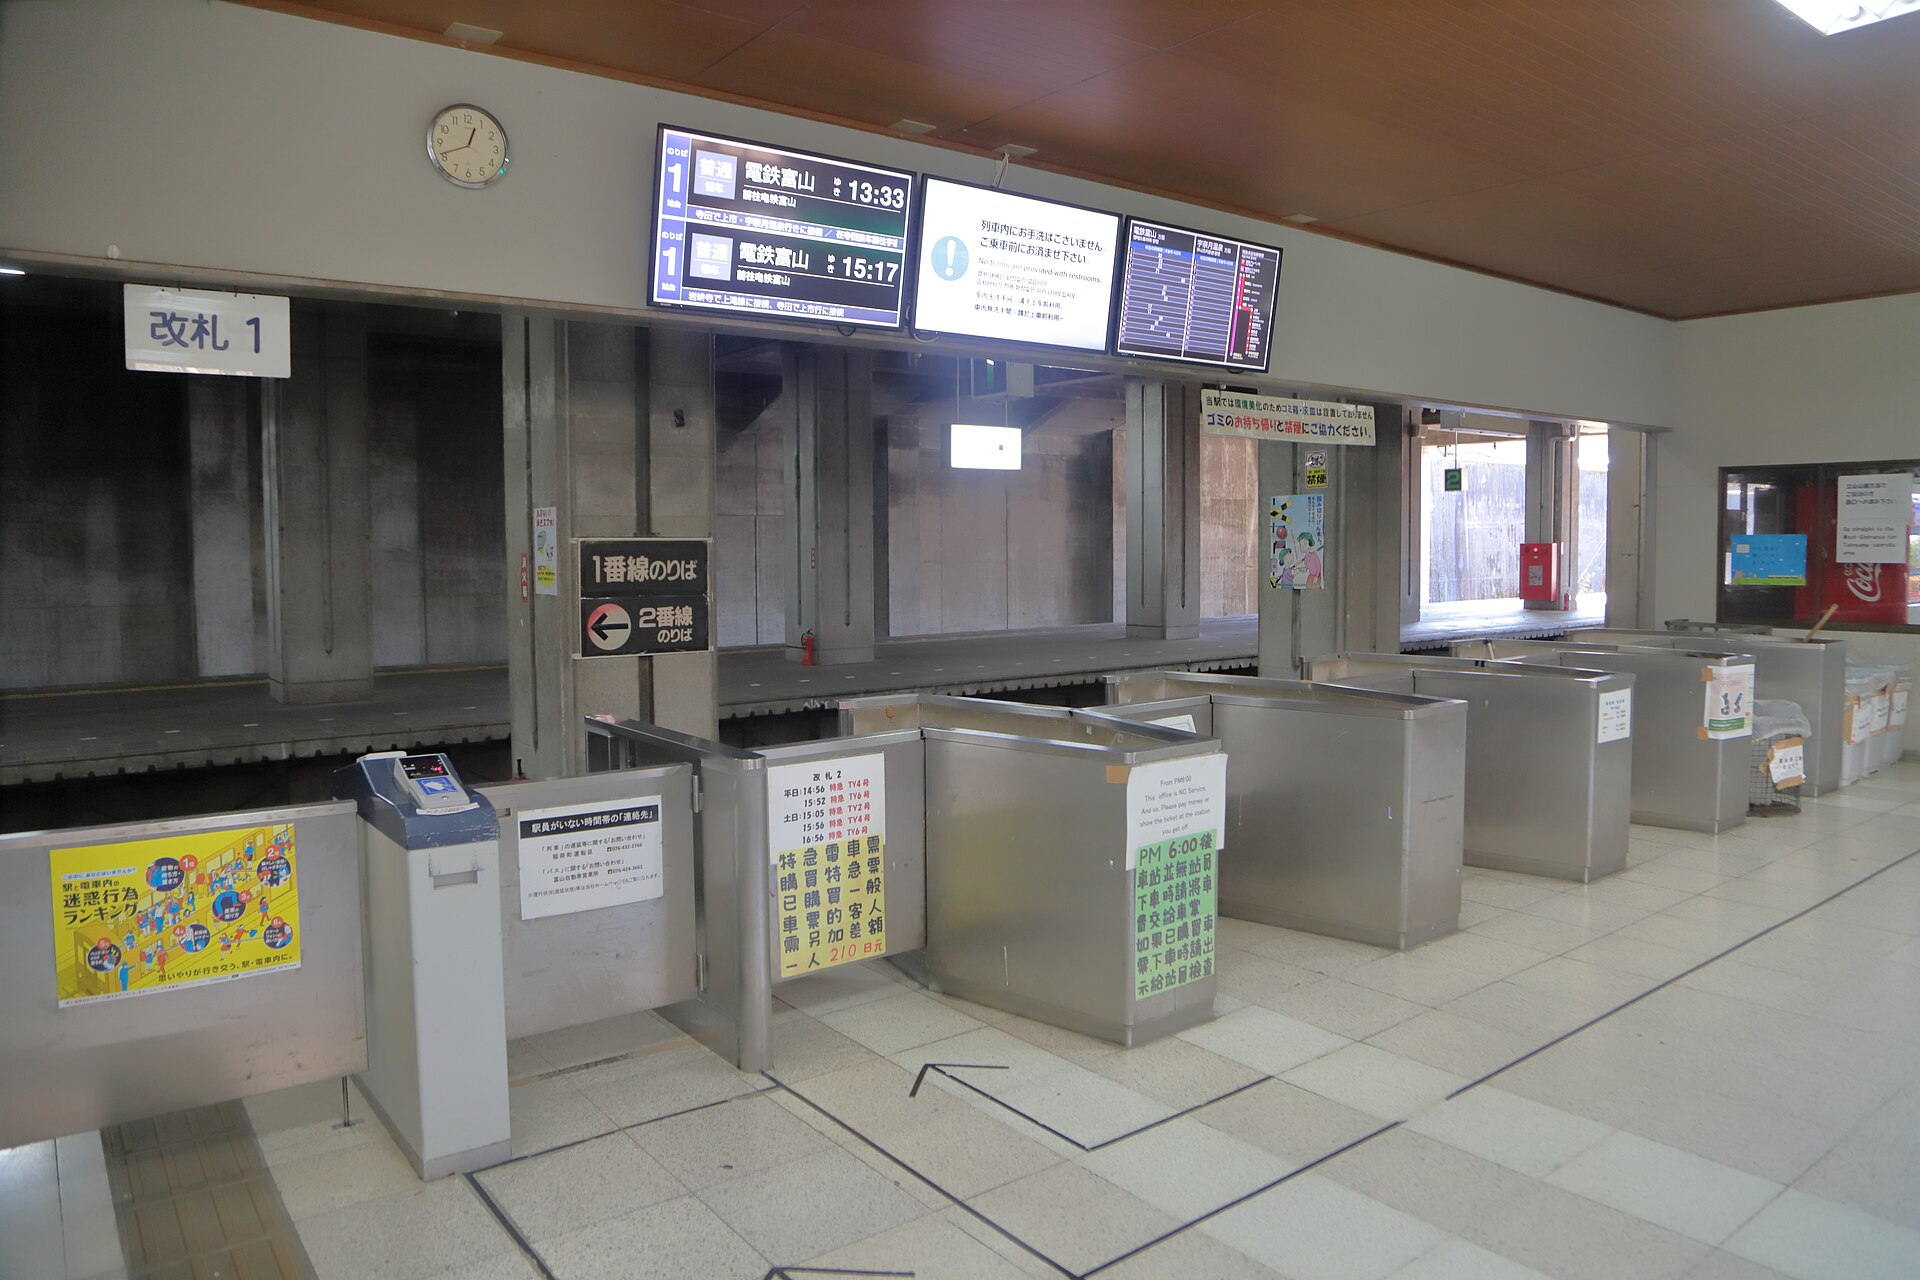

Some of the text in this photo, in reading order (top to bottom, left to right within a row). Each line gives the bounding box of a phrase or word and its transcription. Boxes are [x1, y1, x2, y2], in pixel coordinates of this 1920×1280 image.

[452, 116, 458, 126] 11
[464, 114, 472, 124] 12
[440, 125, 449, 134] 10
[488, 131, 494, 140] 2
[437, 138, 443, 147] 9
[493, 146, 499, 154] 3
[441, 153, 448, 162] 8
[667, 147, 688, 158] のりば
[453, 164, 458, 173] 7
[480, 167, 485, 176] 5
[488, 159, 494, 167] 4
[466, 169, 471, 178] 6
[668, 162, 682, 193] 1
[745, 161, 815, 192] 電鉄富山
[849, 180, 904, 209] 13:33
[662, 232, 683, 241] のりば
[663, 246, 677, 276] 1
[740, 242, 809, 270] 電鉄富山
[842, 256, 899, 283] 15:17
[1024, 265, 1053, 276] provided
[1054, 270, 1068, 278] with
[1068, 273, 1102, 284] restrooms.
[150, 312, 260, 353] 改札 1
[1207, 414, 1372, 438] ゴミのお持ち帰りと禁煙にご協力ください。
[1307, 474, 1327, 485] 禁煙
[1447, 472, 1460, 490] 2
[592, 555, 697, 583] 1番線のりば
[639, 606, 693, 628] 2番線
[658, 628, 693, 643] のりば
[813, 770, 842, 782] 改札 2
[829, 782, 844, 792] 特急
[1158, 792, 1172, 800] office
[1179, 788, 1187, 796] NO
[804, 797, 826, 808] 15:52
[830, 795, 844, 804] 特急
[1161, 802, 1177, 811] Please
[1178, 801, 1187, 809] pay
[1188, 798, 1203, 806] money
[829, 807, 843, 816] 特急
[1140, 820, 1153, 828] show
[1154, 817, 1162, 825] the
[1164, 814, 1178, 823] ticket
[1185, 811, 1193, 819] the
[1194, 808, 1210, 817] station
[532, 810, 652, 833] 駅員がいない時間帯の「連絡先」
[803, 822, 825, 832] 15:56
[829, 819, 843, 828] 特急
[802, 834, 824, 844] 16:56
[828, 831, 842, 840] 特急
[1162, 828, 1172, 836] you
[1173, 827, 1181, 835] get
[779, 835, 880, 870] 特急電車需
[1140, 846, 1161, 866] PM
[780, 857, 880, 892] 購買特急票
[1137, 853, 1212, 890] 車站並無站員
[63, 880, 119, 892] 駅と電車内の
[784, 878, 881, 911] 已購買一般
[1138, 875, 1212, 912] 下車時請將車
[64, 887, 138, 908] 迷惑行為
[64, 902, 138, 926] ランキング
[783, 899, 882, 934] 車票的客人
[784, 916, 883, 954] 需另加差額
[1137, 914, 1213, 953] 如果已購買車
[159, 954, 292, 982] 思いやりが行き交う、駅・電車内に。
